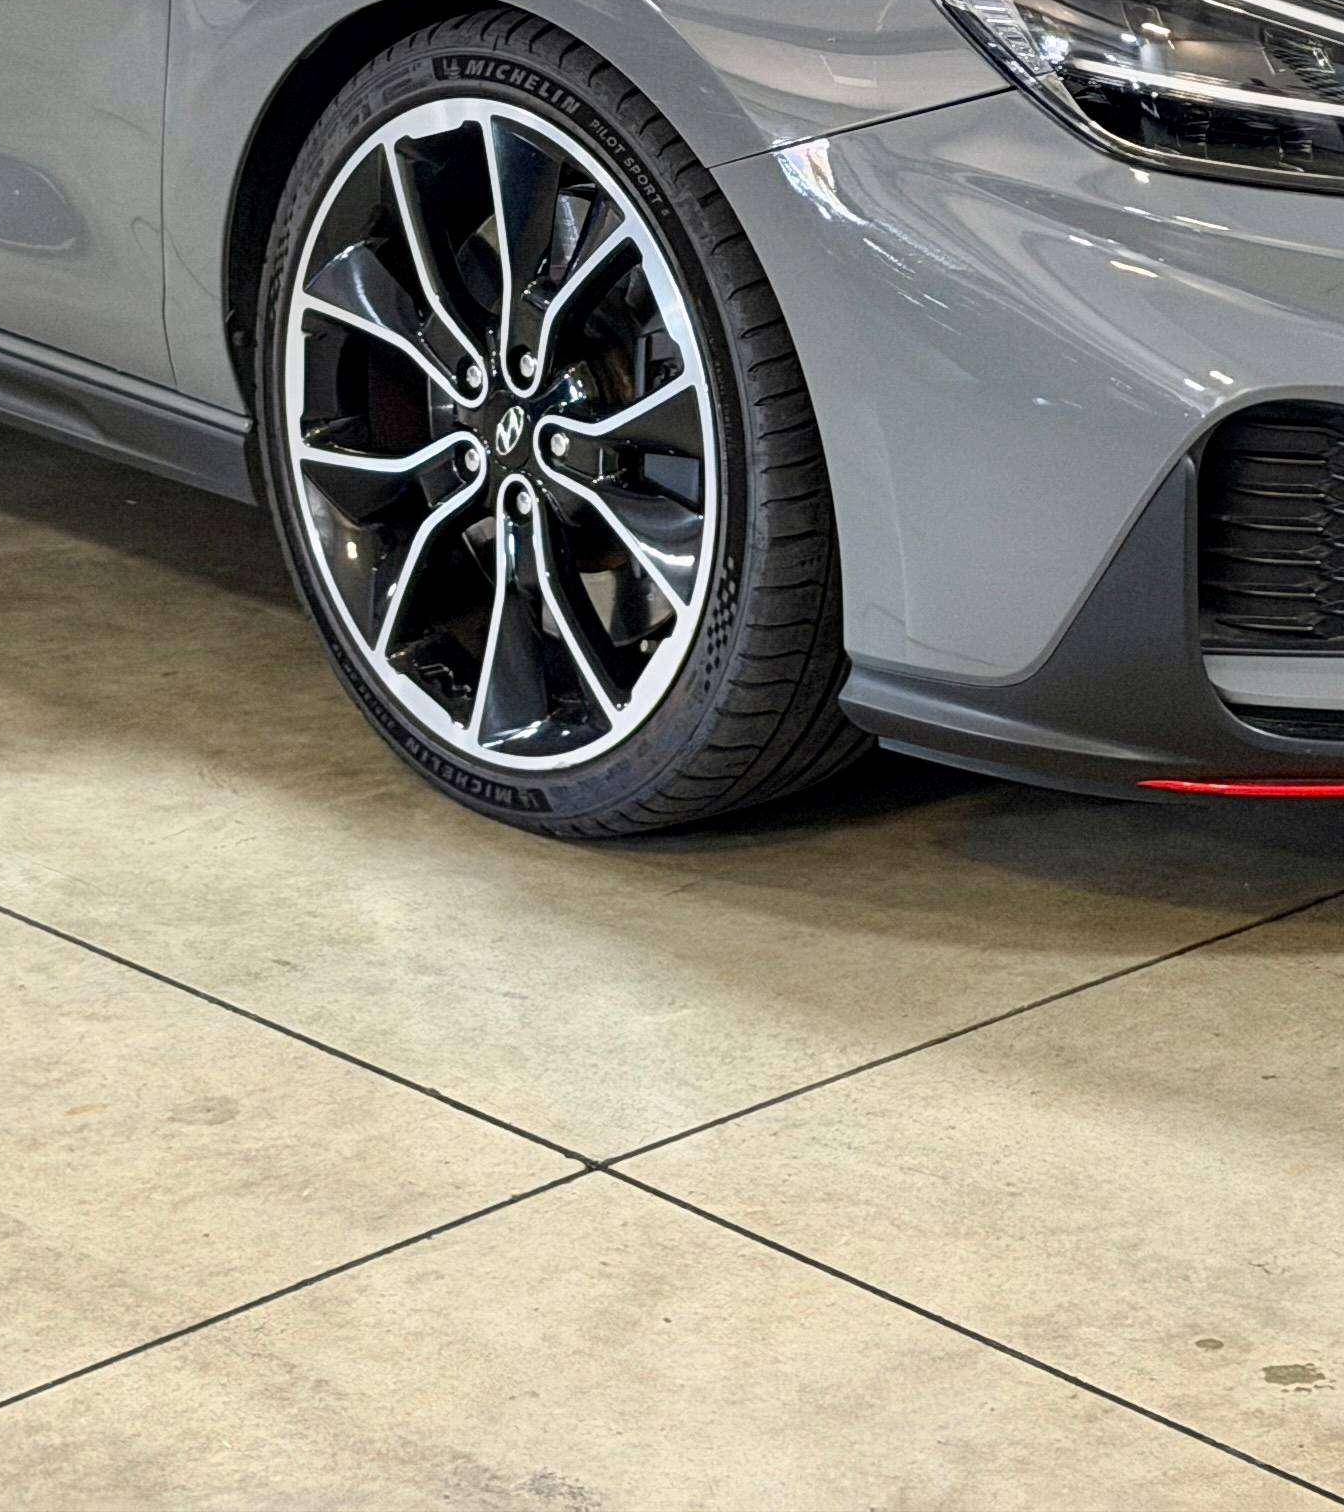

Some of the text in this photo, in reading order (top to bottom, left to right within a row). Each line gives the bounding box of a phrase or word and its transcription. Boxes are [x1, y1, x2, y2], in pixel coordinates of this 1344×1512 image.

[465, 59, 581, 115] MICHELIN
[590, 119, 625, 155] PILOT
[623, 157, 664, 205] SPORT
[406, 736, 513, 804] MICHELIN
